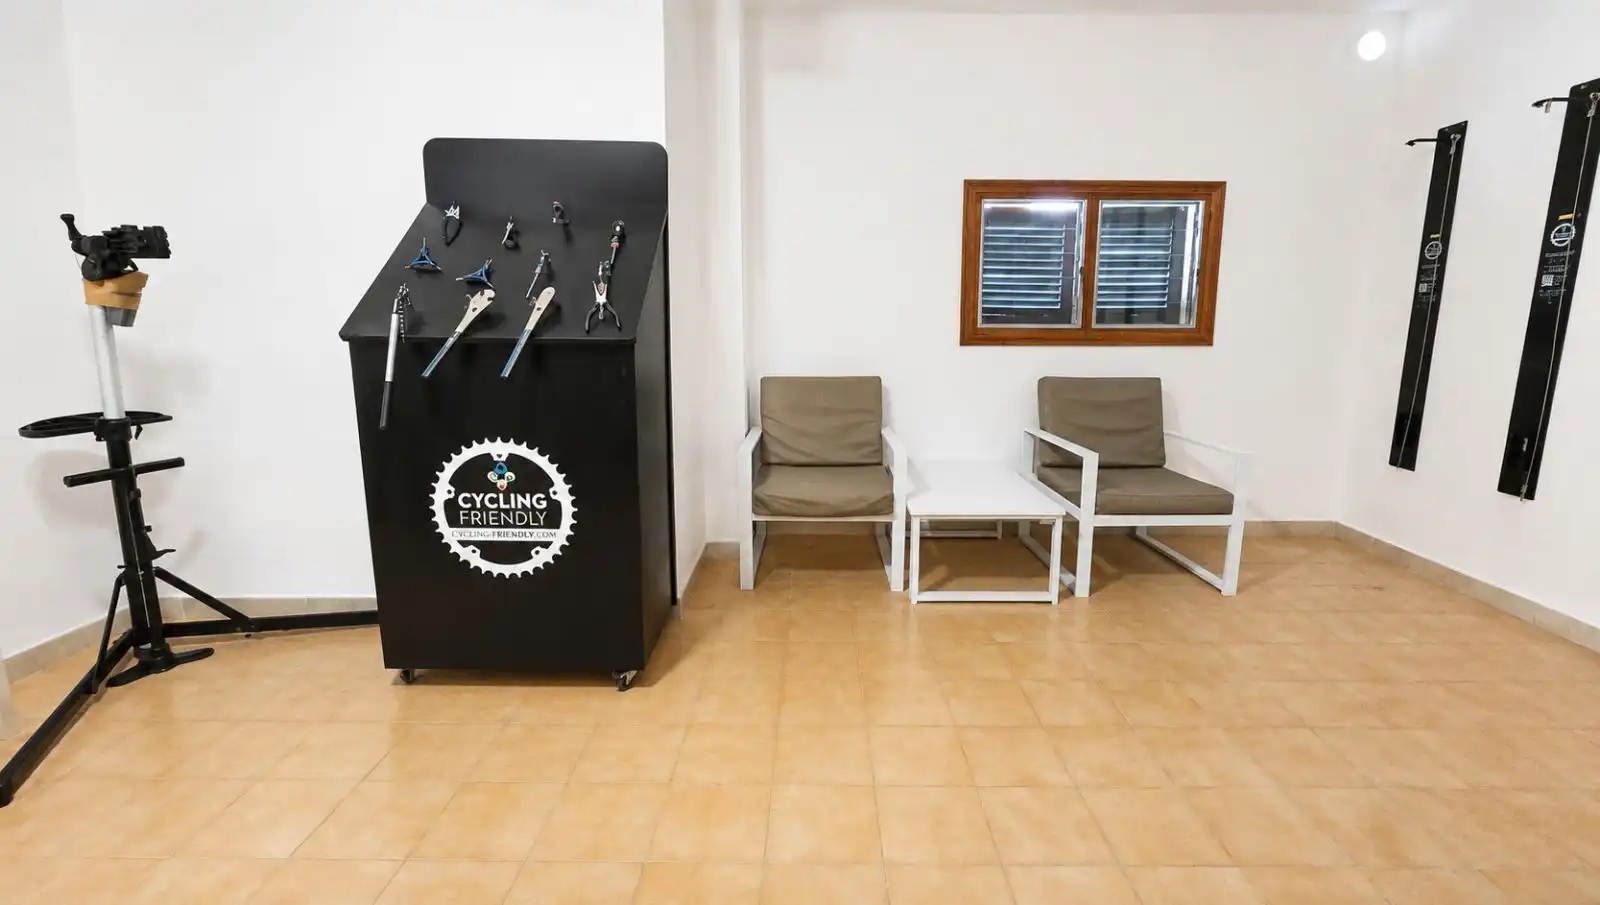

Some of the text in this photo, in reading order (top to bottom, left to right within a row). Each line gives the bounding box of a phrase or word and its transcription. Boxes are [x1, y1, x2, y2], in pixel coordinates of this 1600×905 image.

[457, 493, 548, 509] CYCLING
[459, 511, 547, 526] FRIENDLY
[451, 530, 557, 539] CYCLING-FRIENDLY.COM
